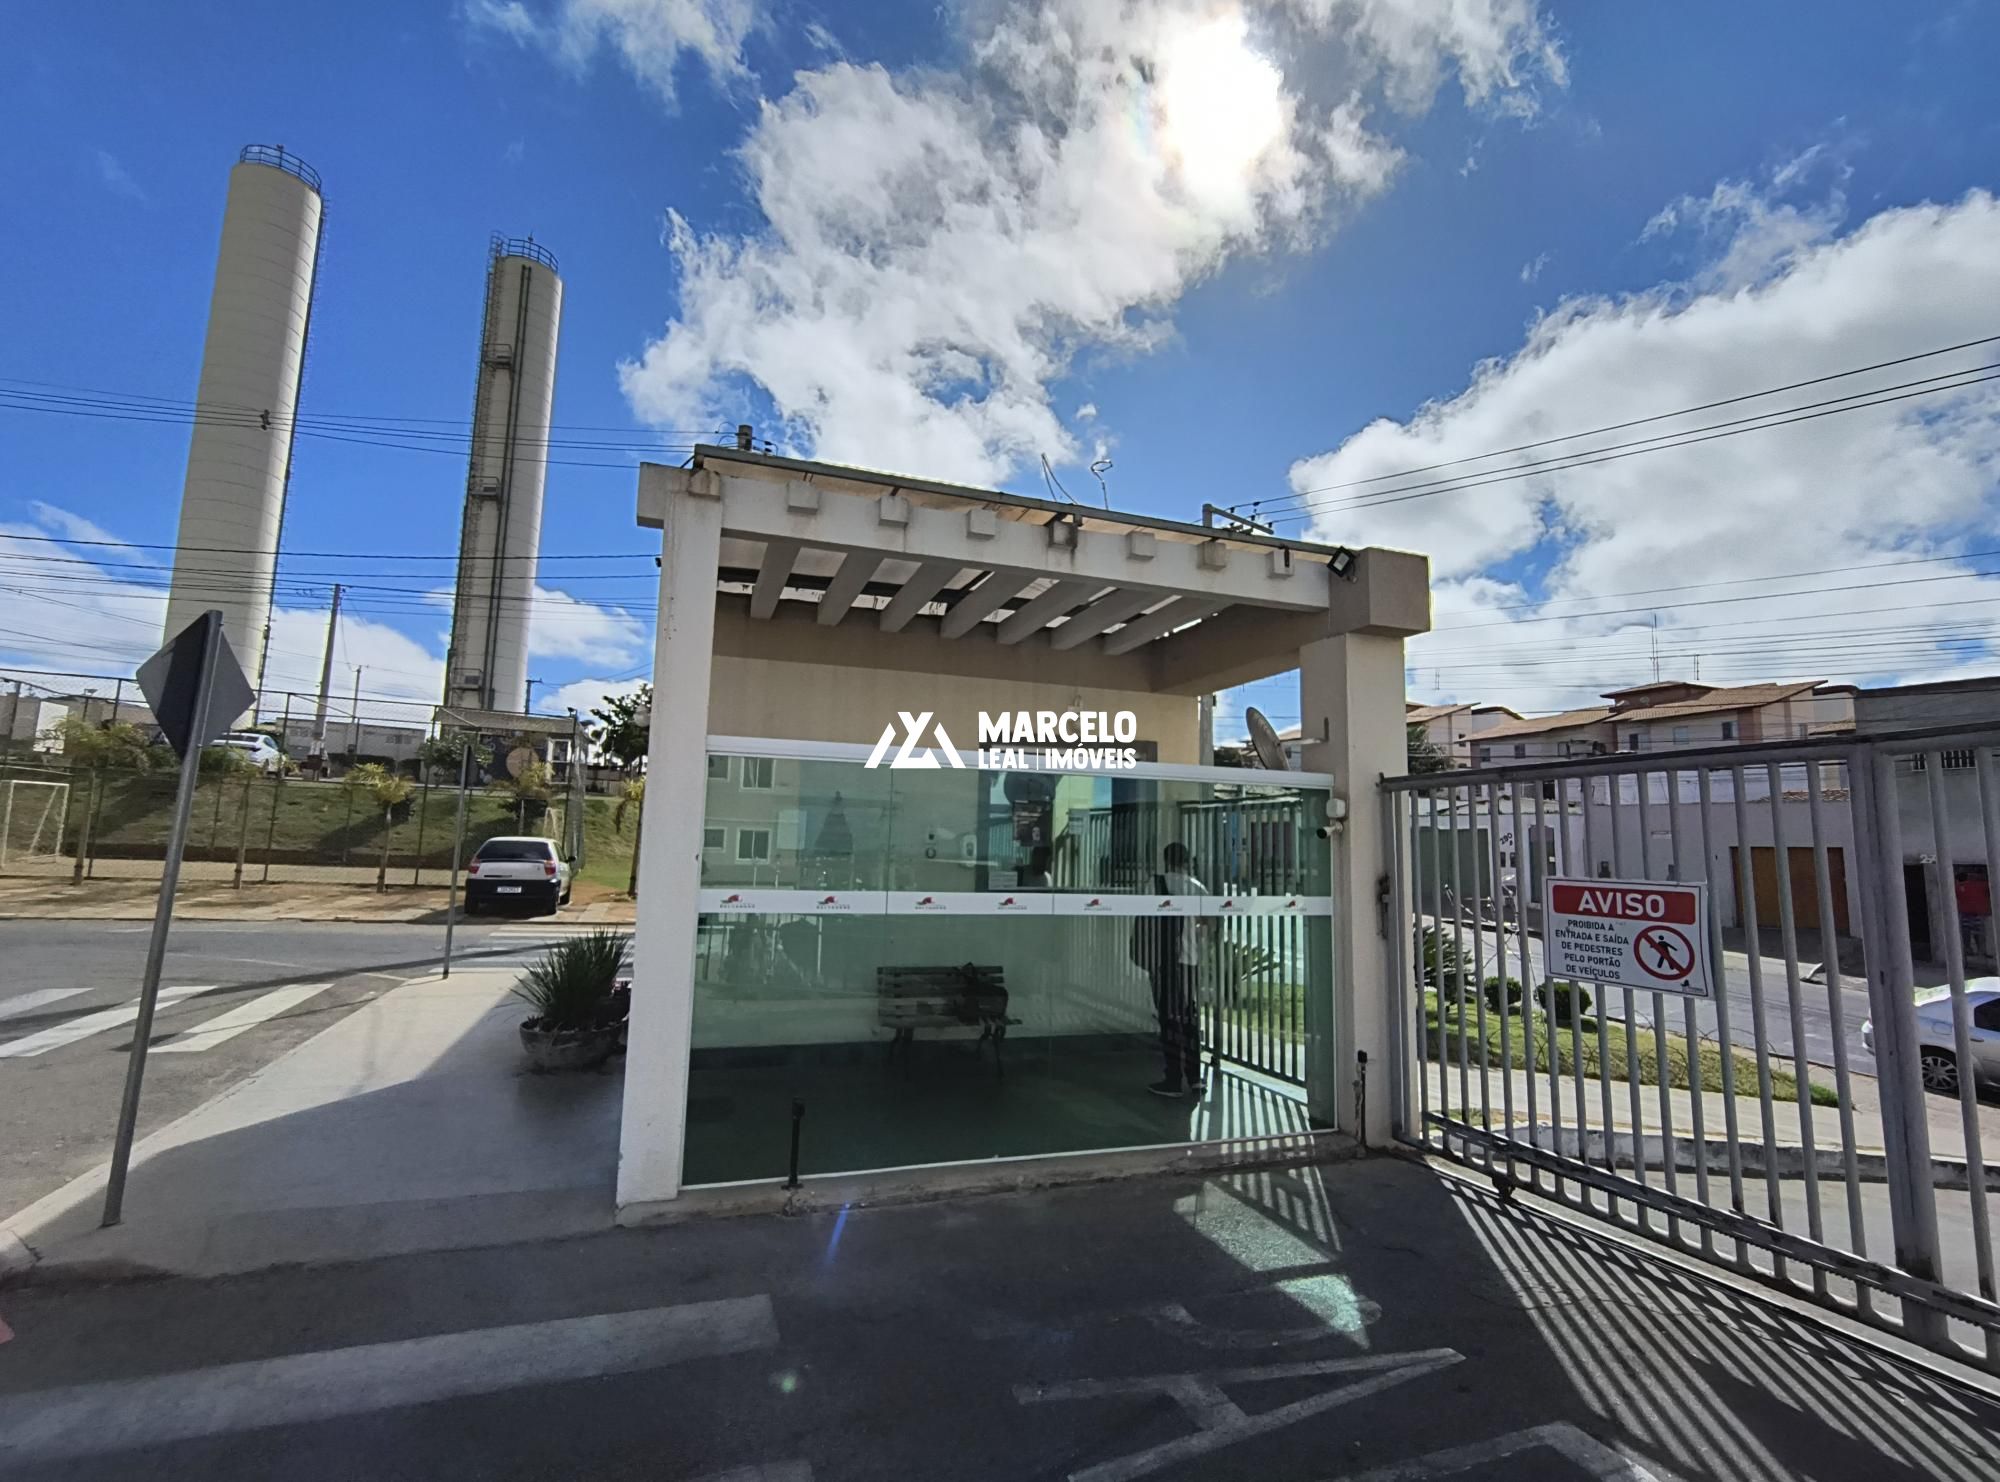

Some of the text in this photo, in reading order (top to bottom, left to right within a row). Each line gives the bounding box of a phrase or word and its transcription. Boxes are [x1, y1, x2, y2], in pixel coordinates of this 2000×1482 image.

[1578, 890, 1665, 918] AVISO
[1568, 919, 1615, 931] PROIBIDA A
[1555, 929, 1630, 945] ENTRADA E SAÍDA
[1561, 941, 1623, 956] DE PEDESTRES
[1564, 952, 1621, 968] PELO PORTÃO
[1566, 964, 1620, 979] DE VEÍCULOS
